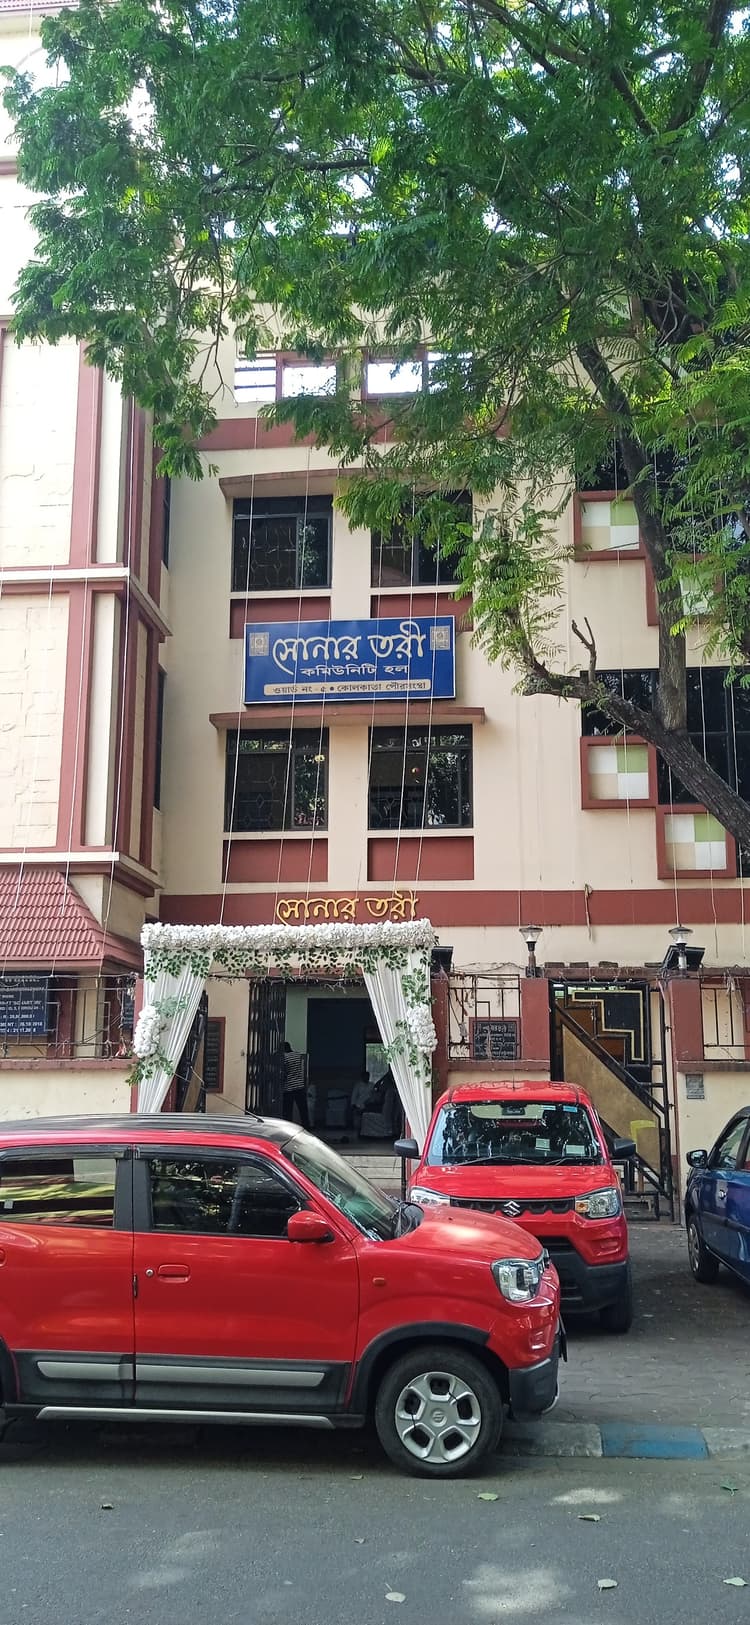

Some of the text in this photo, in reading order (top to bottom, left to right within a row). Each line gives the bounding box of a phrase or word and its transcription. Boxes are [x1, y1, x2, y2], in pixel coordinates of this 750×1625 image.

[272, 620, 426, 676] সোনার তরী
[300, 663, 408, 677] কমিউনিটি হল
[336, 682, 382, 692] কোলকাতা
[276, 885, 418, 926] সোনার তরী
